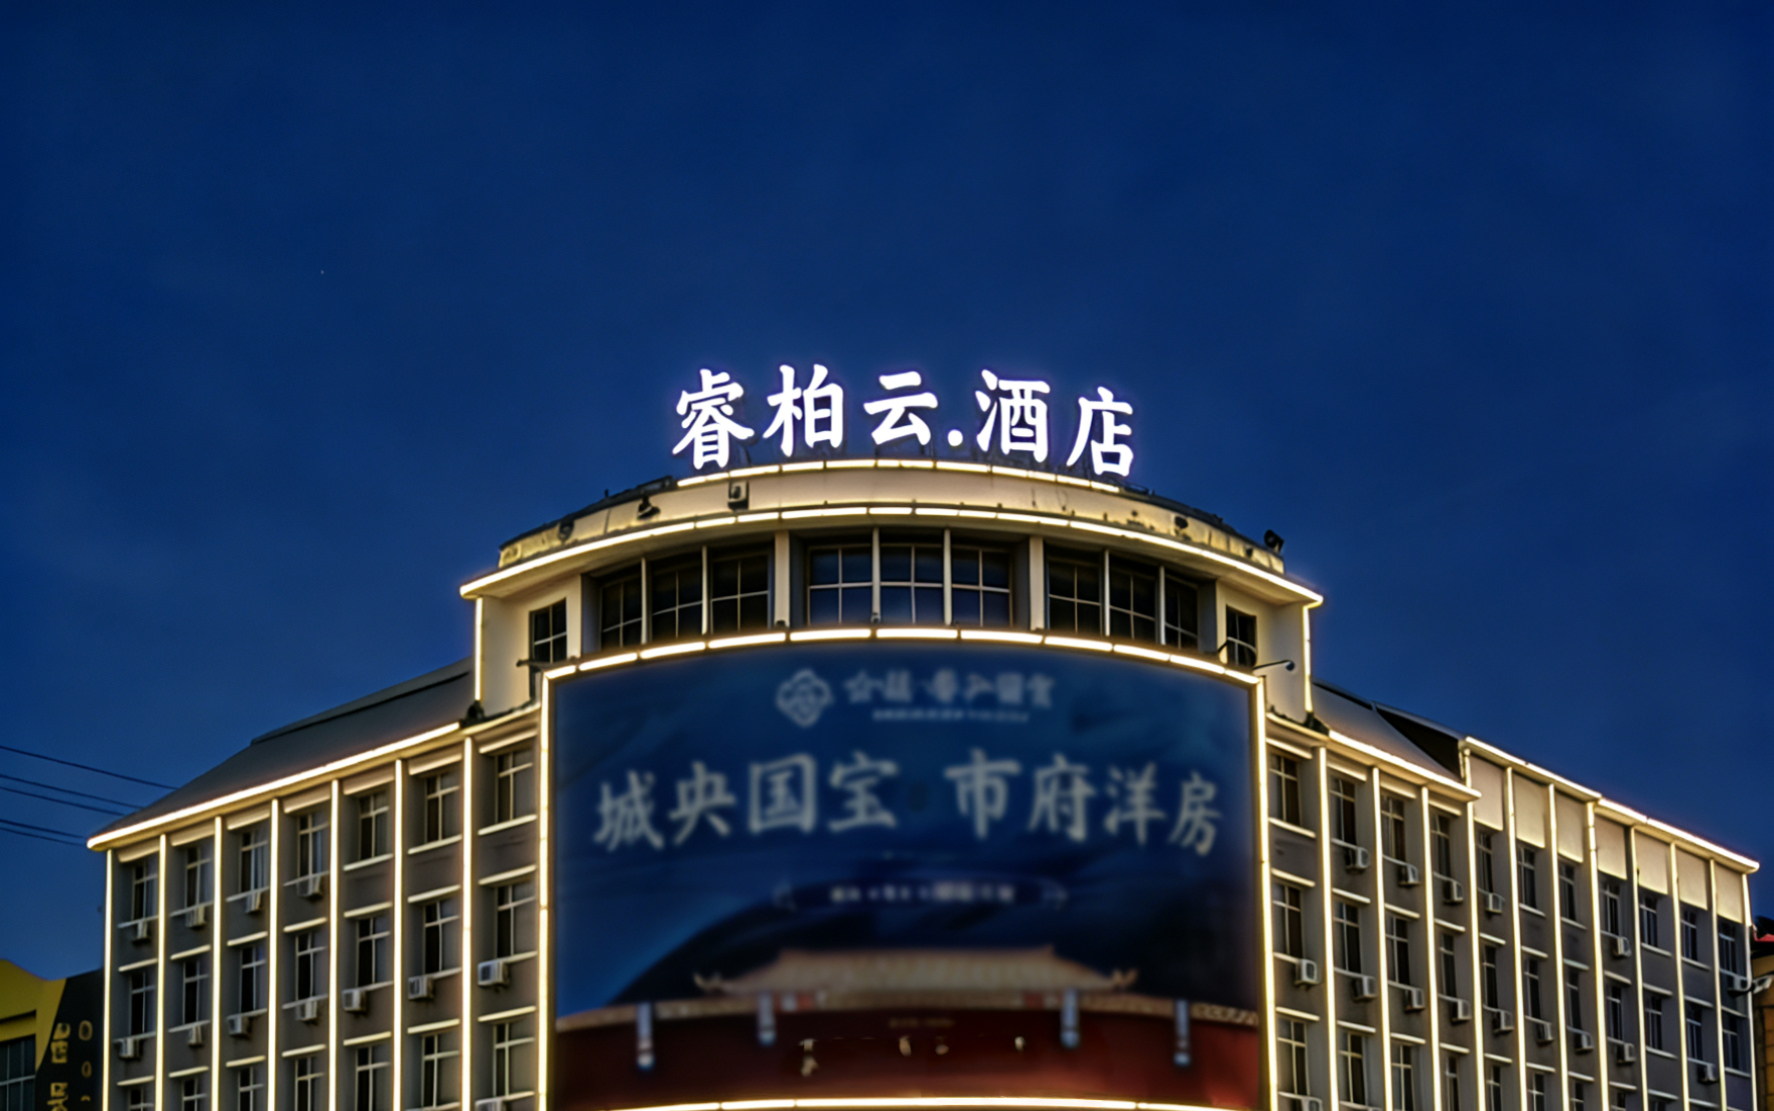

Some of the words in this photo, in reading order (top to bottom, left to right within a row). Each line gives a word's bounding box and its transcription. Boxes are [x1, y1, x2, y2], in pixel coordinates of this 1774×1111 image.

[594, 752, 897, 851] 城央国宝
[945, 749, 1222, 854] 市府洋房
